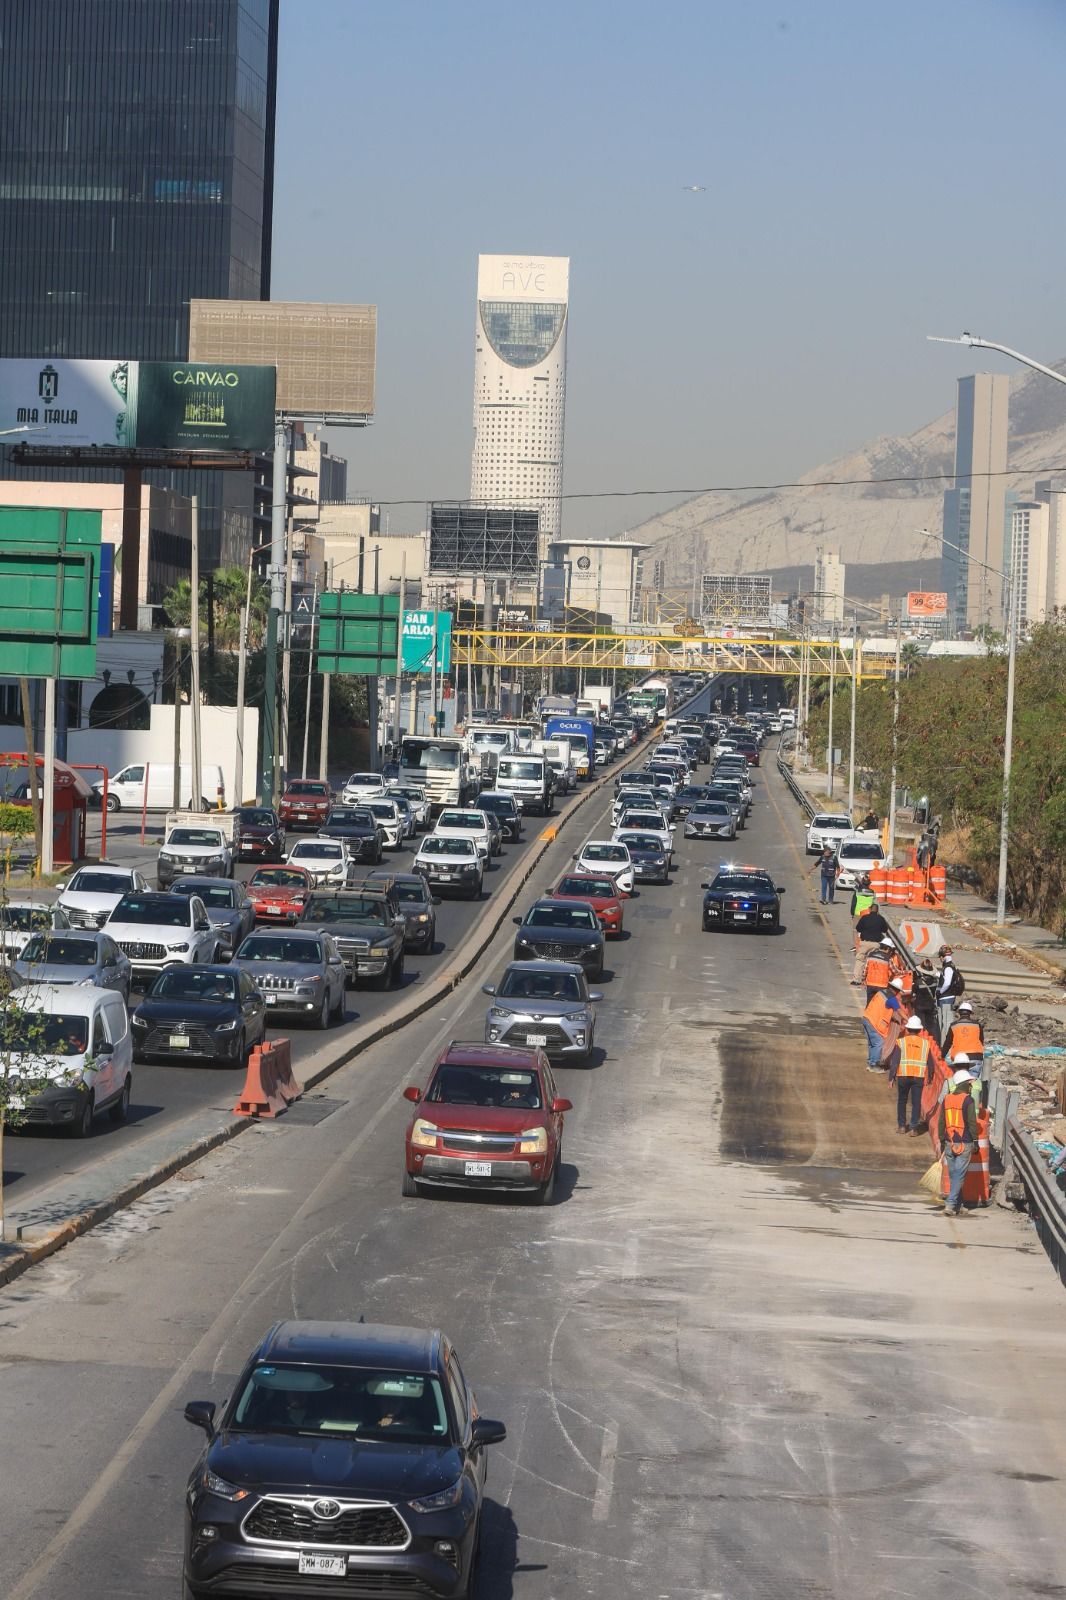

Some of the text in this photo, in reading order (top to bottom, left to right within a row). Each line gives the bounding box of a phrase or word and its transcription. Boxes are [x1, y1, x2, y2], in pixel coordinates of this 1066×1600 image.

[503, 271, 544, 292] AVE
[172, 370, 239, 387] CARVAO
[16, 407, 78, 425] MIA ITALIA
[405, 613, 428, 624] SAN
[402, 624, 436, 636] ARLOS
